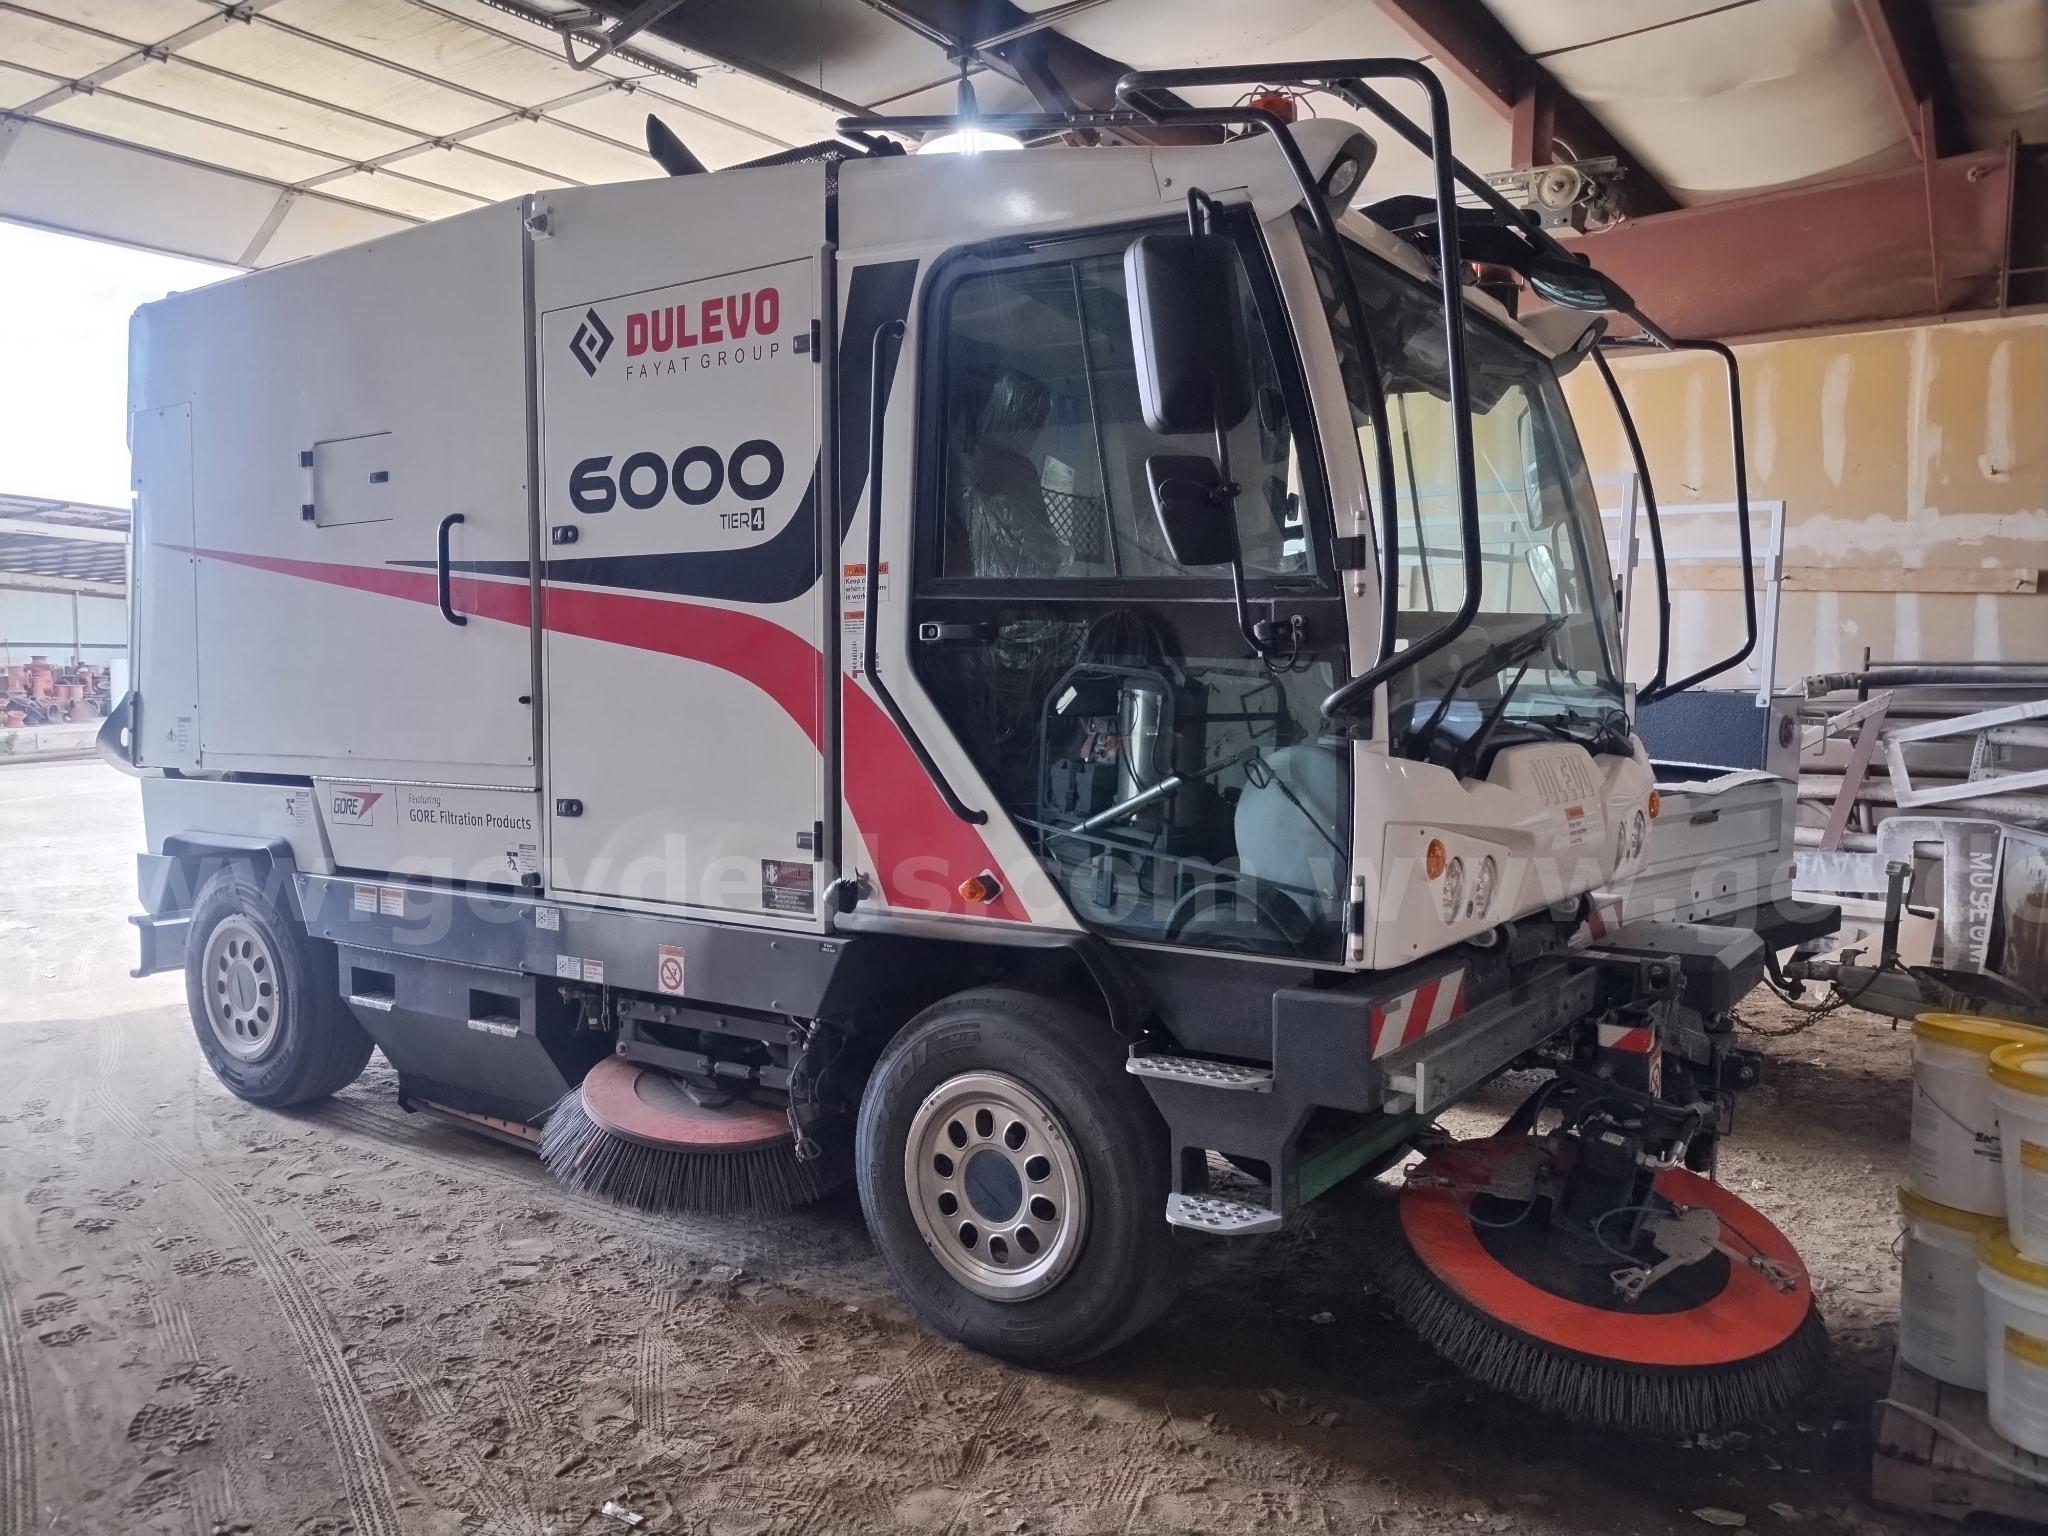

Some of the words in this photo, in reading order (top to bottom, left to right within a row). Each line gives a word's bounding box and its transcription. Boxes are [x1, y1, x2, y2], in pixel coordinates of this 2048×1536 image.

[626, 287, 780, 357] DULEVO
[626, 356, 690, 381] FAYAT
[700, 342, 780, 370] GROUP
[568, 438, 785, 515] 6000
[333, 797, 359, 815] GORE
[408, 793, 441, 807] Featuring
[440, 810, 483, 827] Filtration
[486, 813, 532, 831] Products
[1969, 851, 1993, 963] MUSEUM
